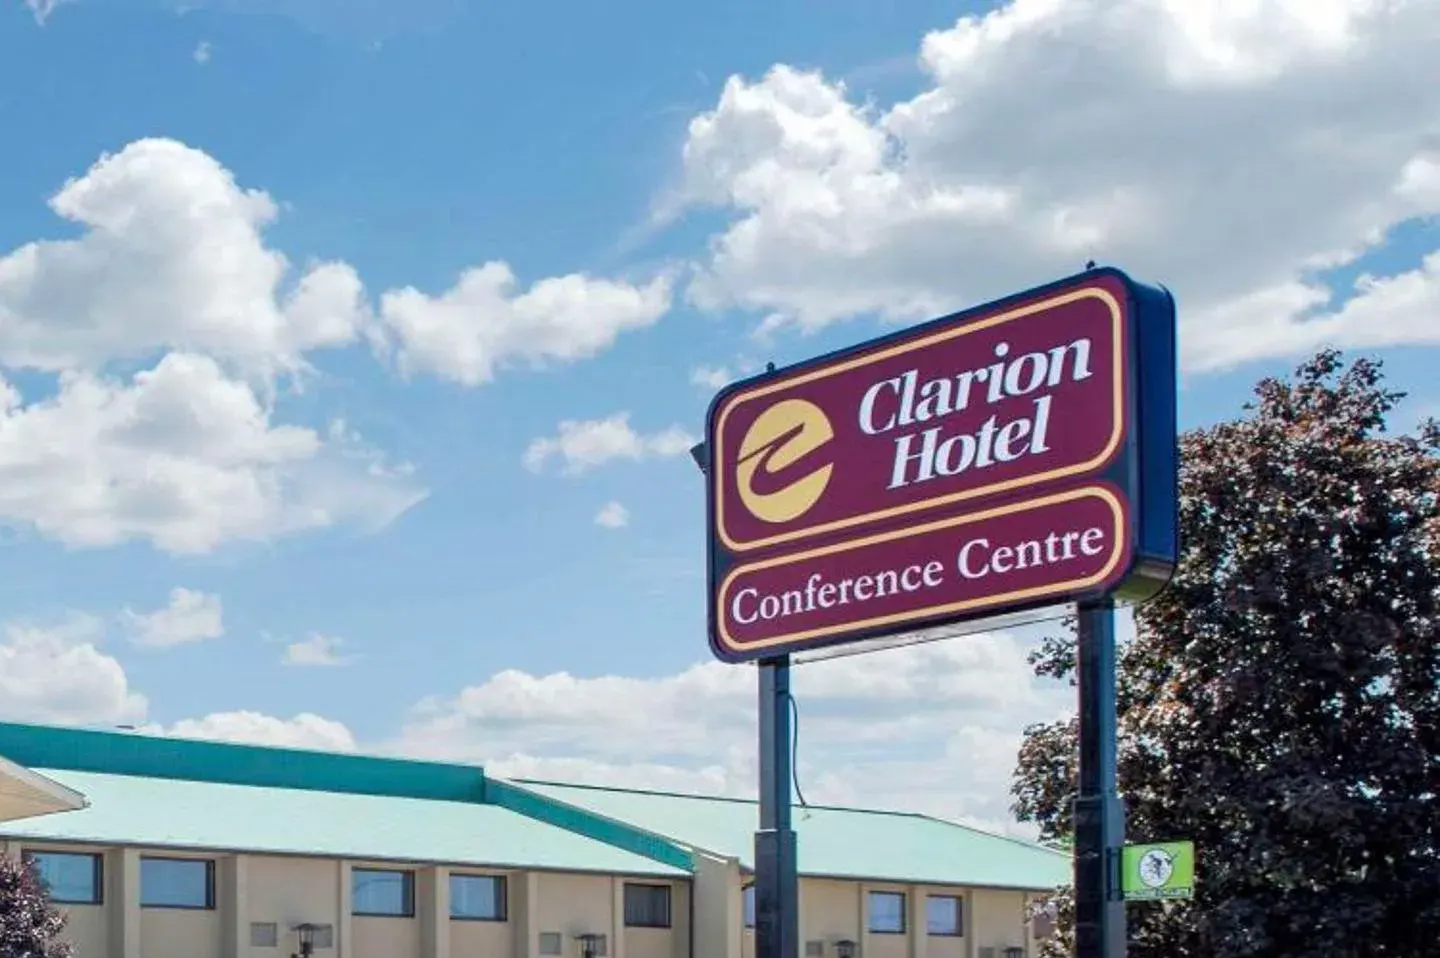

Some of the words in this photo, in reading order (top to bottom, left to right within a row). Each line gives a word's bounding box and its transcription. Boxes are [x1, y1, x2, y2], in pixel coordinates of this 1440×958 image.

[859, 337, 1092, 434] Clarion
[887, 395, 1051, 489] Hotel
[732, 561, 943, 624] Conference
[958, 526, 1104, 579] Centre
